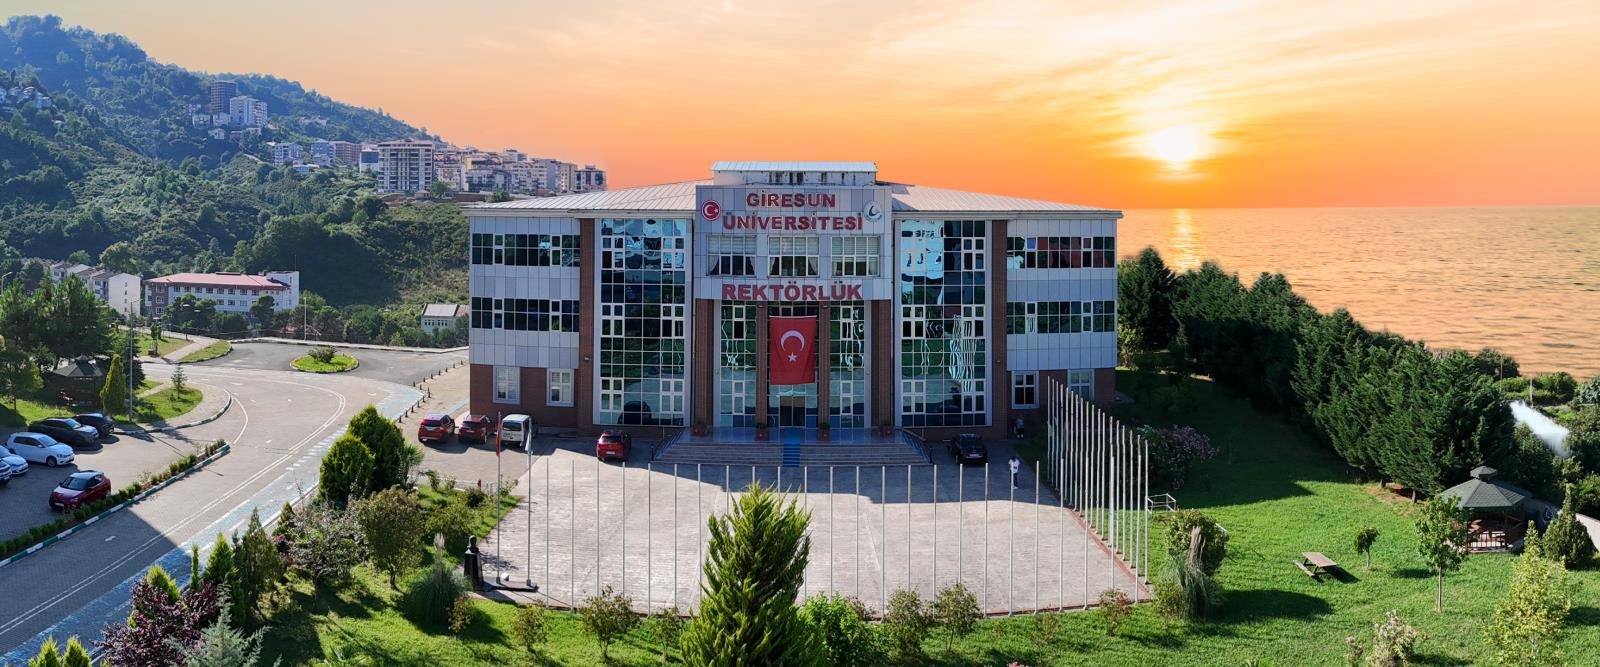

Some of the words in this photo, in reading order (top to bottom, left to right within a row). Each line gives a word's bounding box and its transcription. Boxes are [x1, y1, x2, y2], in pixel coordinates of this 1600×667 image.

[746, 190, 836, 208] GİRESUN
[723, 212, 863, 231] ÜNİVERSİTESİ
[721, 280, 863, 301] REKTÖRLÜK
